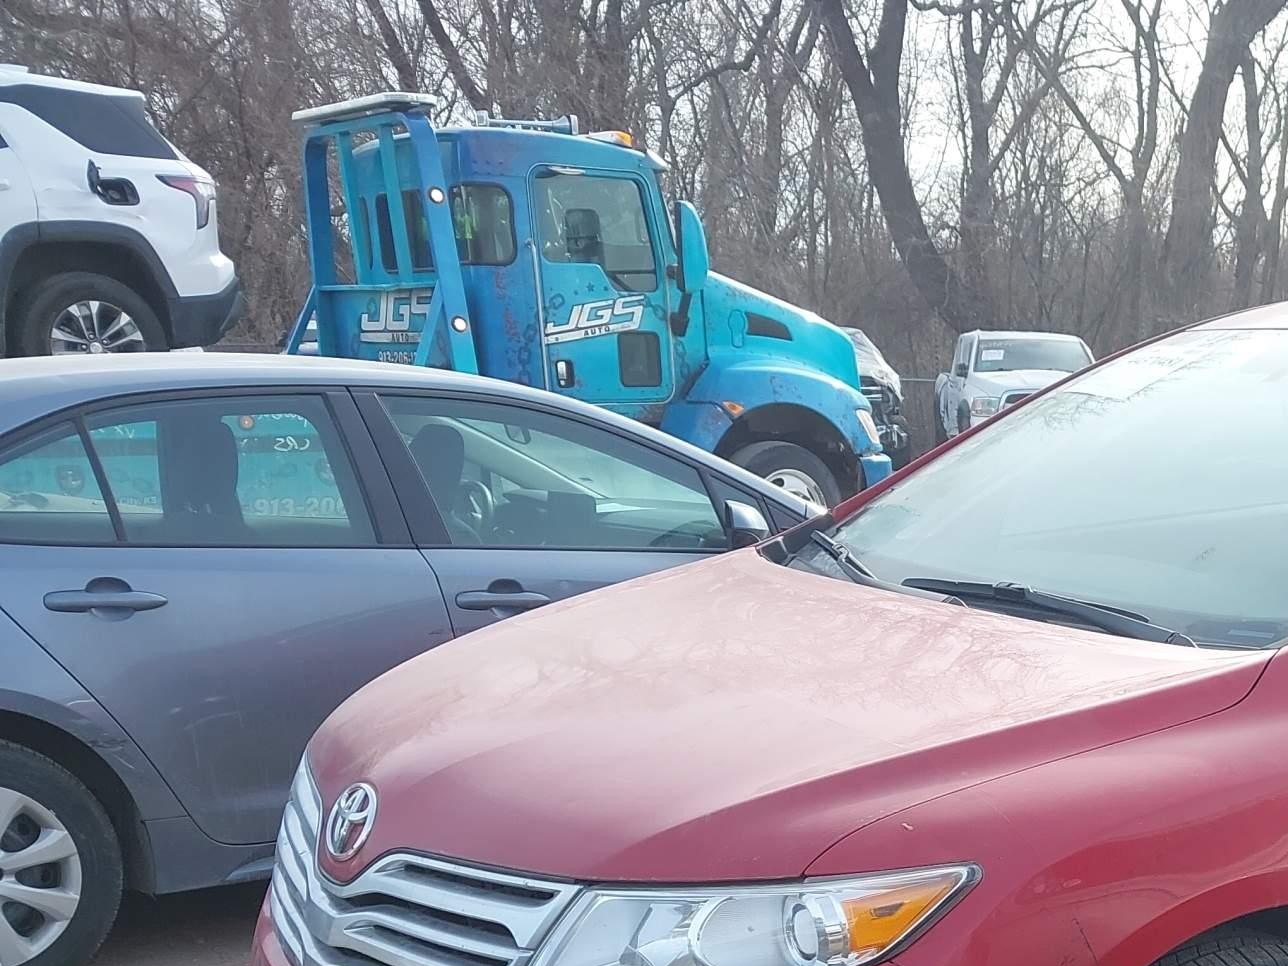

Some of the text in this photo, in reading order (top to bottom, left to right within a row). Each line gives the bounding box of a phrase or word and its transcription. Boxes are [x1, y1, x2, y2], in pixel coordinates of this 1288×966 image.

[361, 288, 434, 331] JGS
[544, 295, 645, 334] JGS
[583, 326, 611, 337] AUTO
